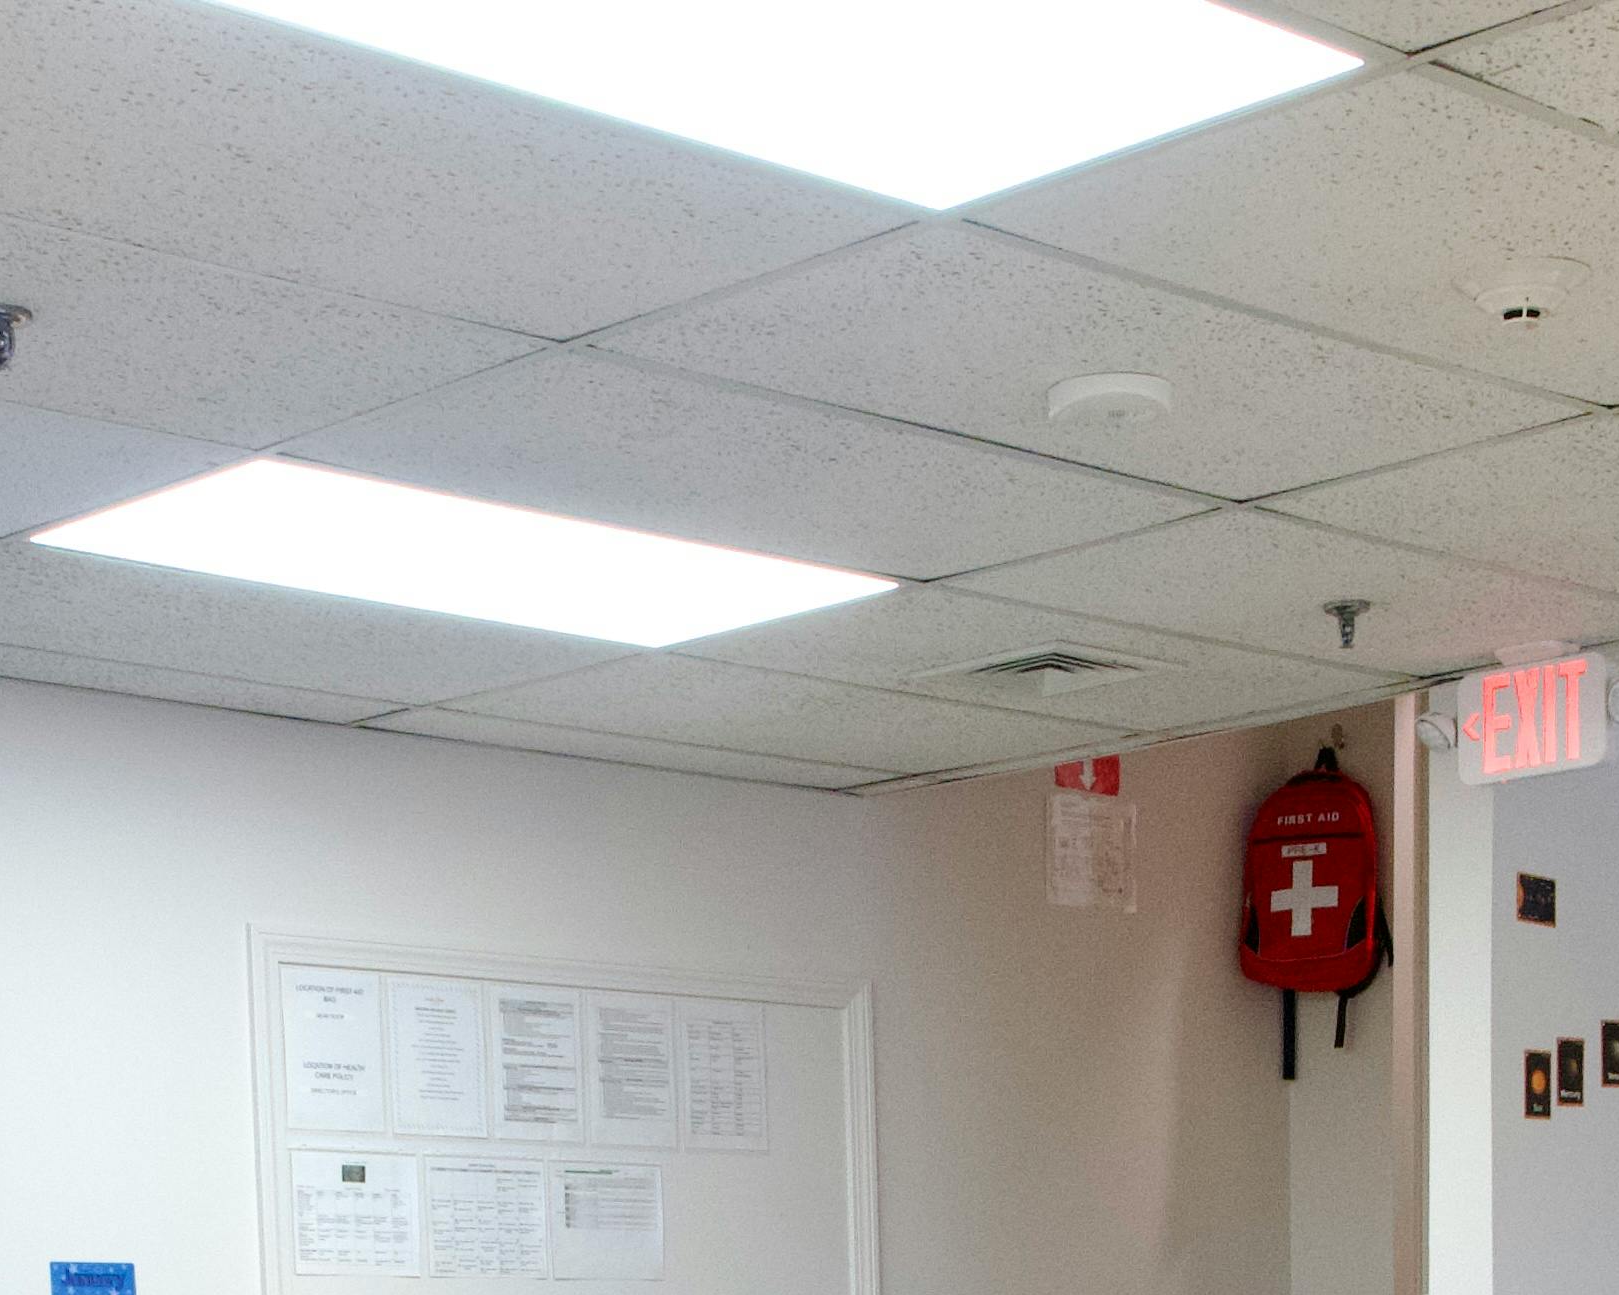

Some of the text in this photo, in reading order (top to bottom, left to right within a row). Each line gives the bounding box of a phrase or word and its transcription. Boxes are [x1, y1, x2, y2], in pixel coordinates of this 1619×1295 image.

[1483, 658, 1588, 776] EXIT
[1277, 811, 1340, 827] FIRST AID
